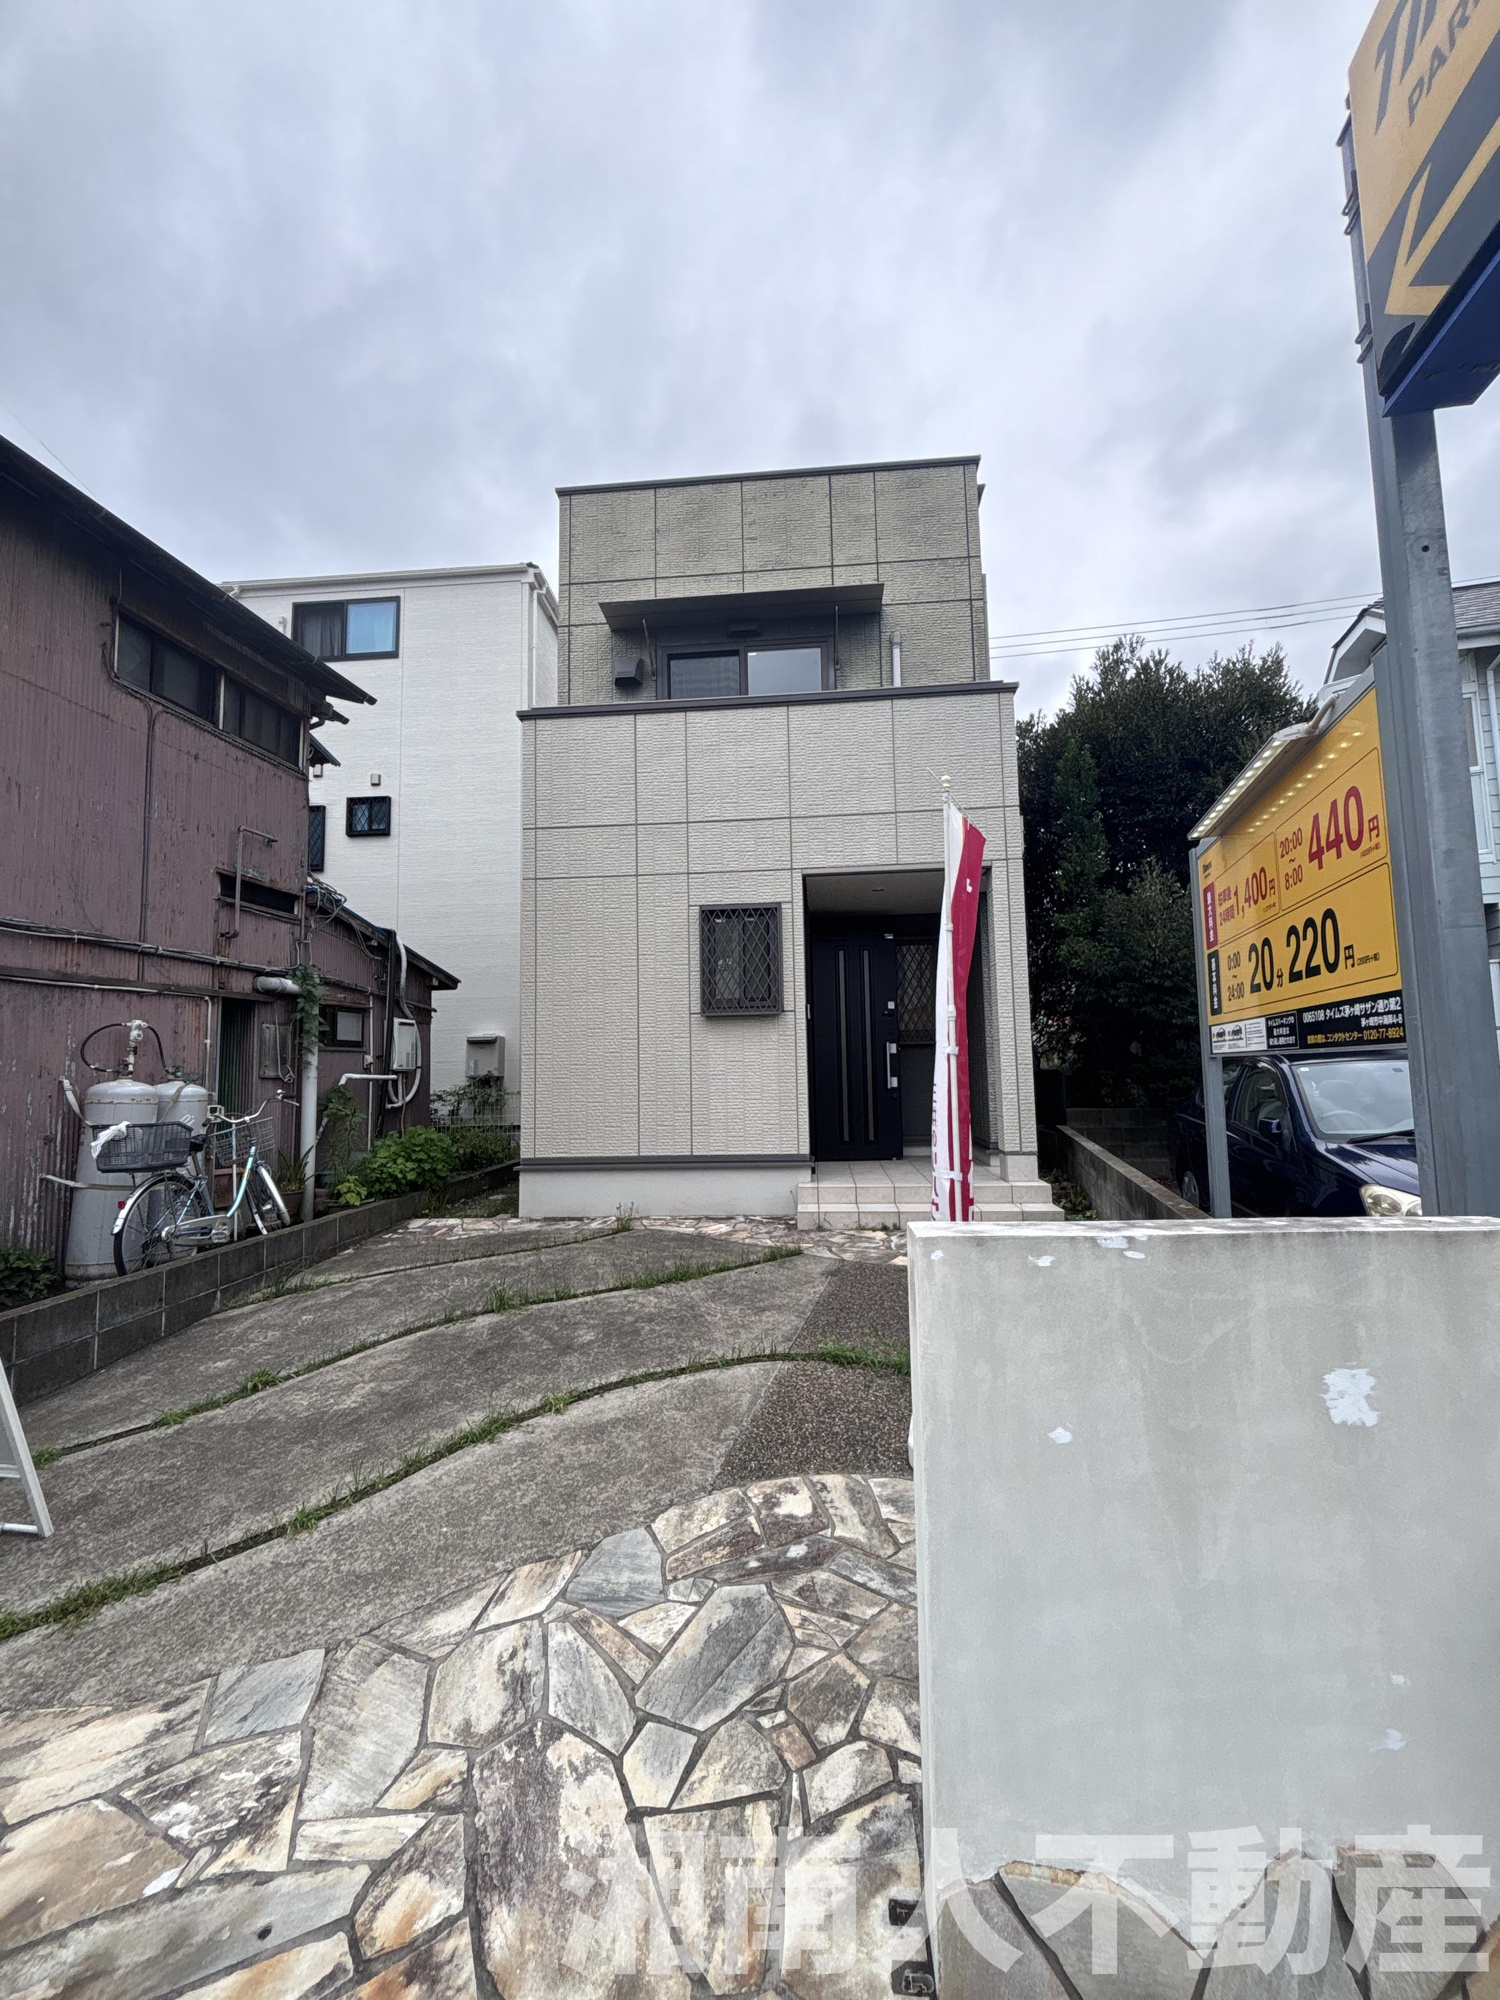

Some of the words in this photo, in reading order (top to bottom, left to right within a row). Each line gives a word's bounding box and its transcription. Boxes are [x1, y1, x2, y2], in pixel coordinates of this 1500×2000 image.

[1408, 0, 1480, 127] PAR
[1280, 827, 1303, 859] 20:00
[1308, 785, 1380, 871] 440円
[1234, 866, 1276, 919] 1,400円
[1284, 864, 1303, 891] 8:00
[1227, 951, 1241, 971] 0:00
[1286, 908, 1356, 984] 220円
[1227, 981, 1245, 1001] 24:00
